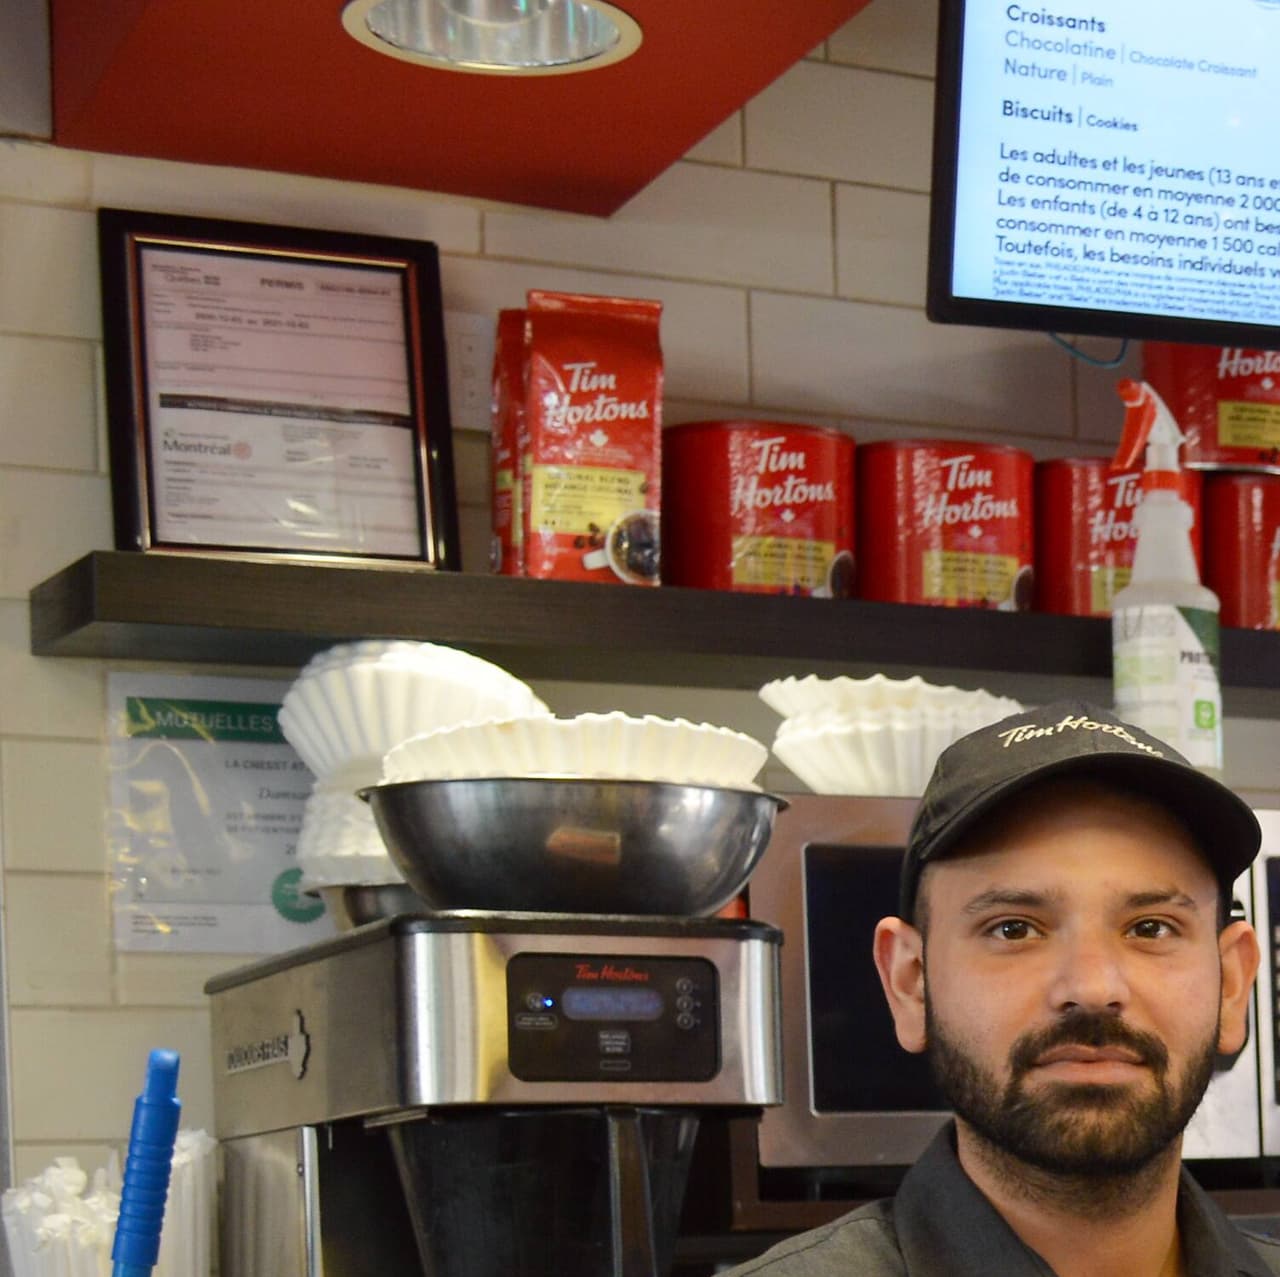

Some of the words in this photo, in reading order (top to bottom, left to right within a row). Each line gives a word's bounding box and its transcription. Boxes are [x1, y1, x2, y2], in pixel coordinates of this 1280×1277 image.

[1006, 4, 1106, 33] Croissants
[1004, 30, 1117, 60] Chocolatine
[1129, 50, 1195, 71] Chocolate
[1197, 59, 1258, 78] Croissant
[1003, 58, 1068, 82] Nature
[1080, 71, 1115, 87] Plain
[1001, 99, 1074, 124] Biscuits
[1086, 113, 1139, 132] Cookies
[1000, 142, 1028, 161] Les
[1032, 148, 1098, 169] adultes
[1102, 156, 1119, 172] et
[1123, 156, 1145, 175] les
[1147, 159, 1205, 182] jeunes
[1208, 166, 1232, 188] (13
[1235, 173, 1265, 189] ans
[998, 165, 1021, 183] de
[1025, 172, 1130, 196] consommer
[1132, 184, 1154, 199] en
[1157, 186, 1236, 209] moyenne
[562, 361, 616, 393] Tim
[546, 393, 649, 428] Hortons
[750, 435, 806, 475] Tim
[941, 455, 993, 491] Tim
[731, 474, 836, 512] Hortons
[922, 493, 1019, 527] Hortons
[575, 964, 600, 980] Tim
